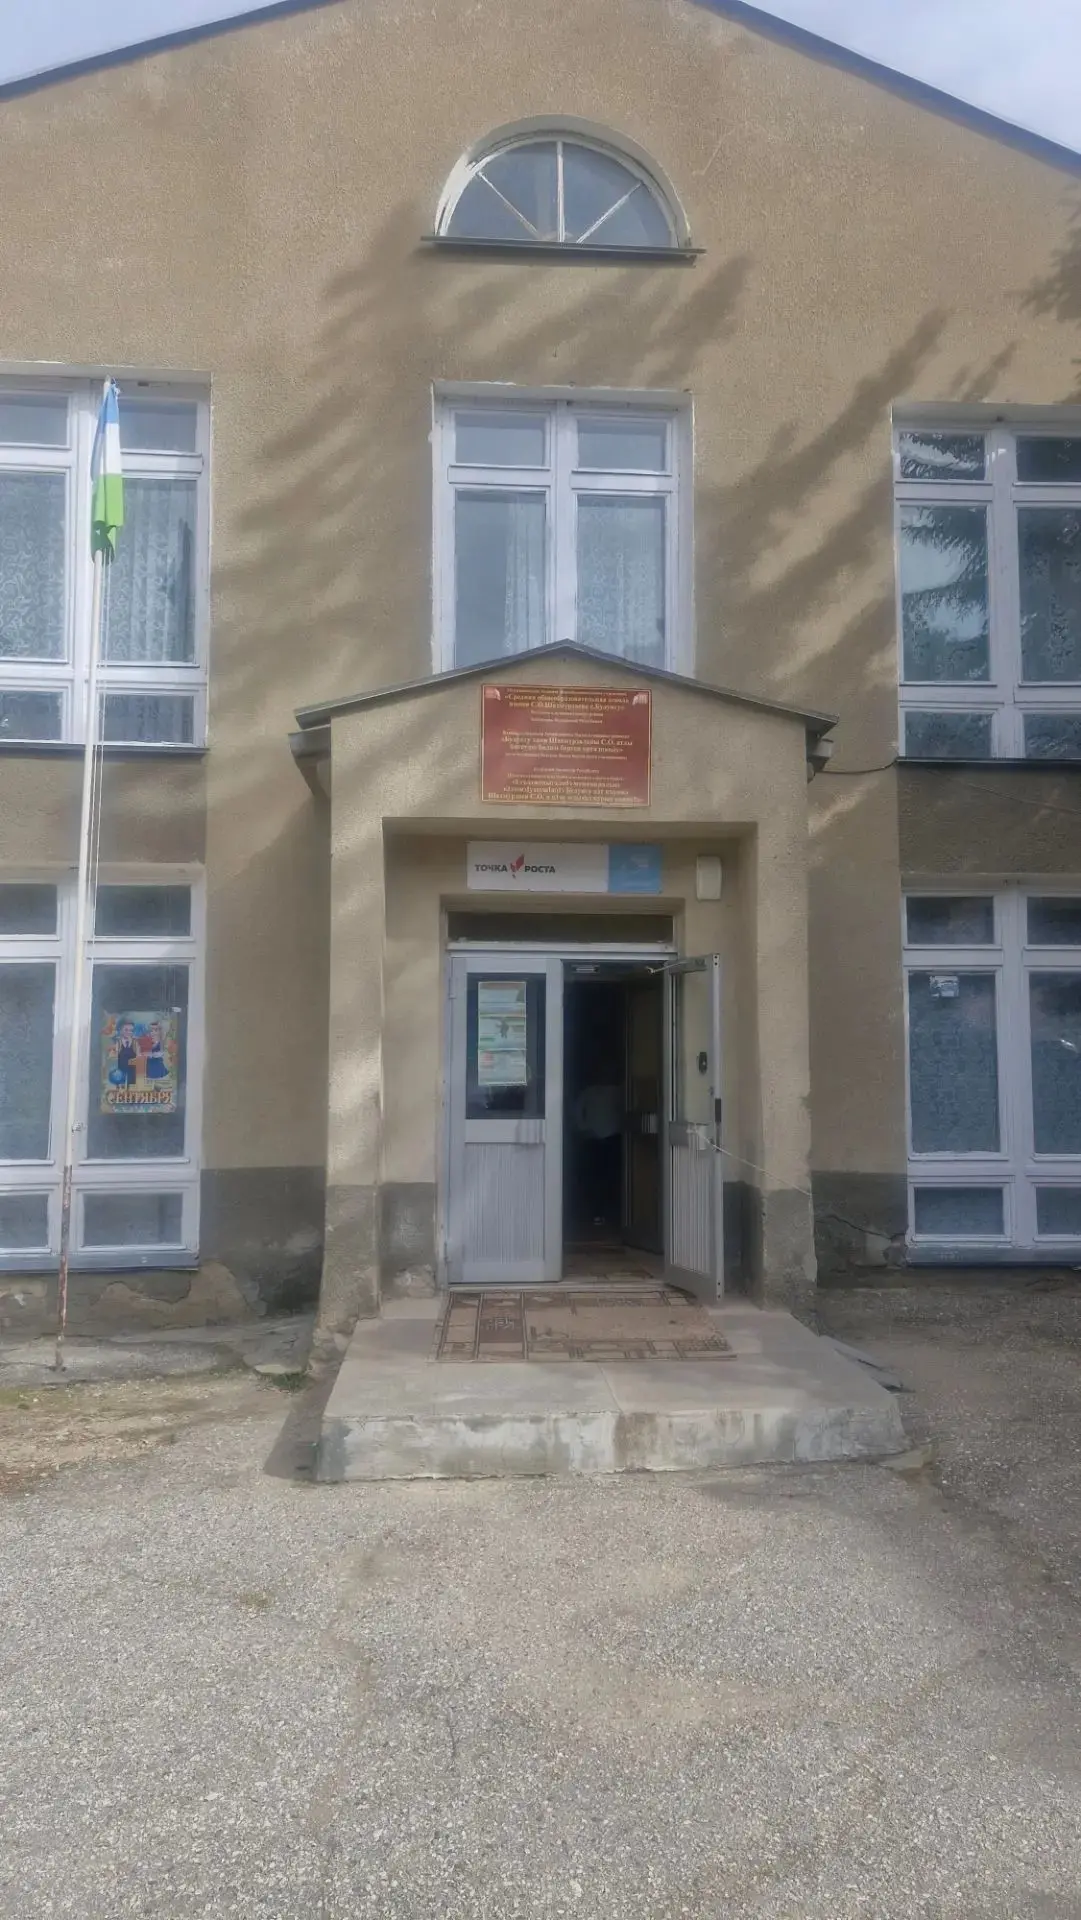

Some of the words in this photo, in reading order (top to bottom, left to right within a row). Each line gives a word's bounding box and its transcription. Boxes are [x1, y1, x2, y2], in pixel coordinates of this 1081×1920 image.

[475, 864, 508, 872] ТОЧКА
[525, 865, 556, 873] РОСТА
[128, 1055, 153, 1091] 1
[107, 1090, 173, 1104] СЕНТЯБРЯ
